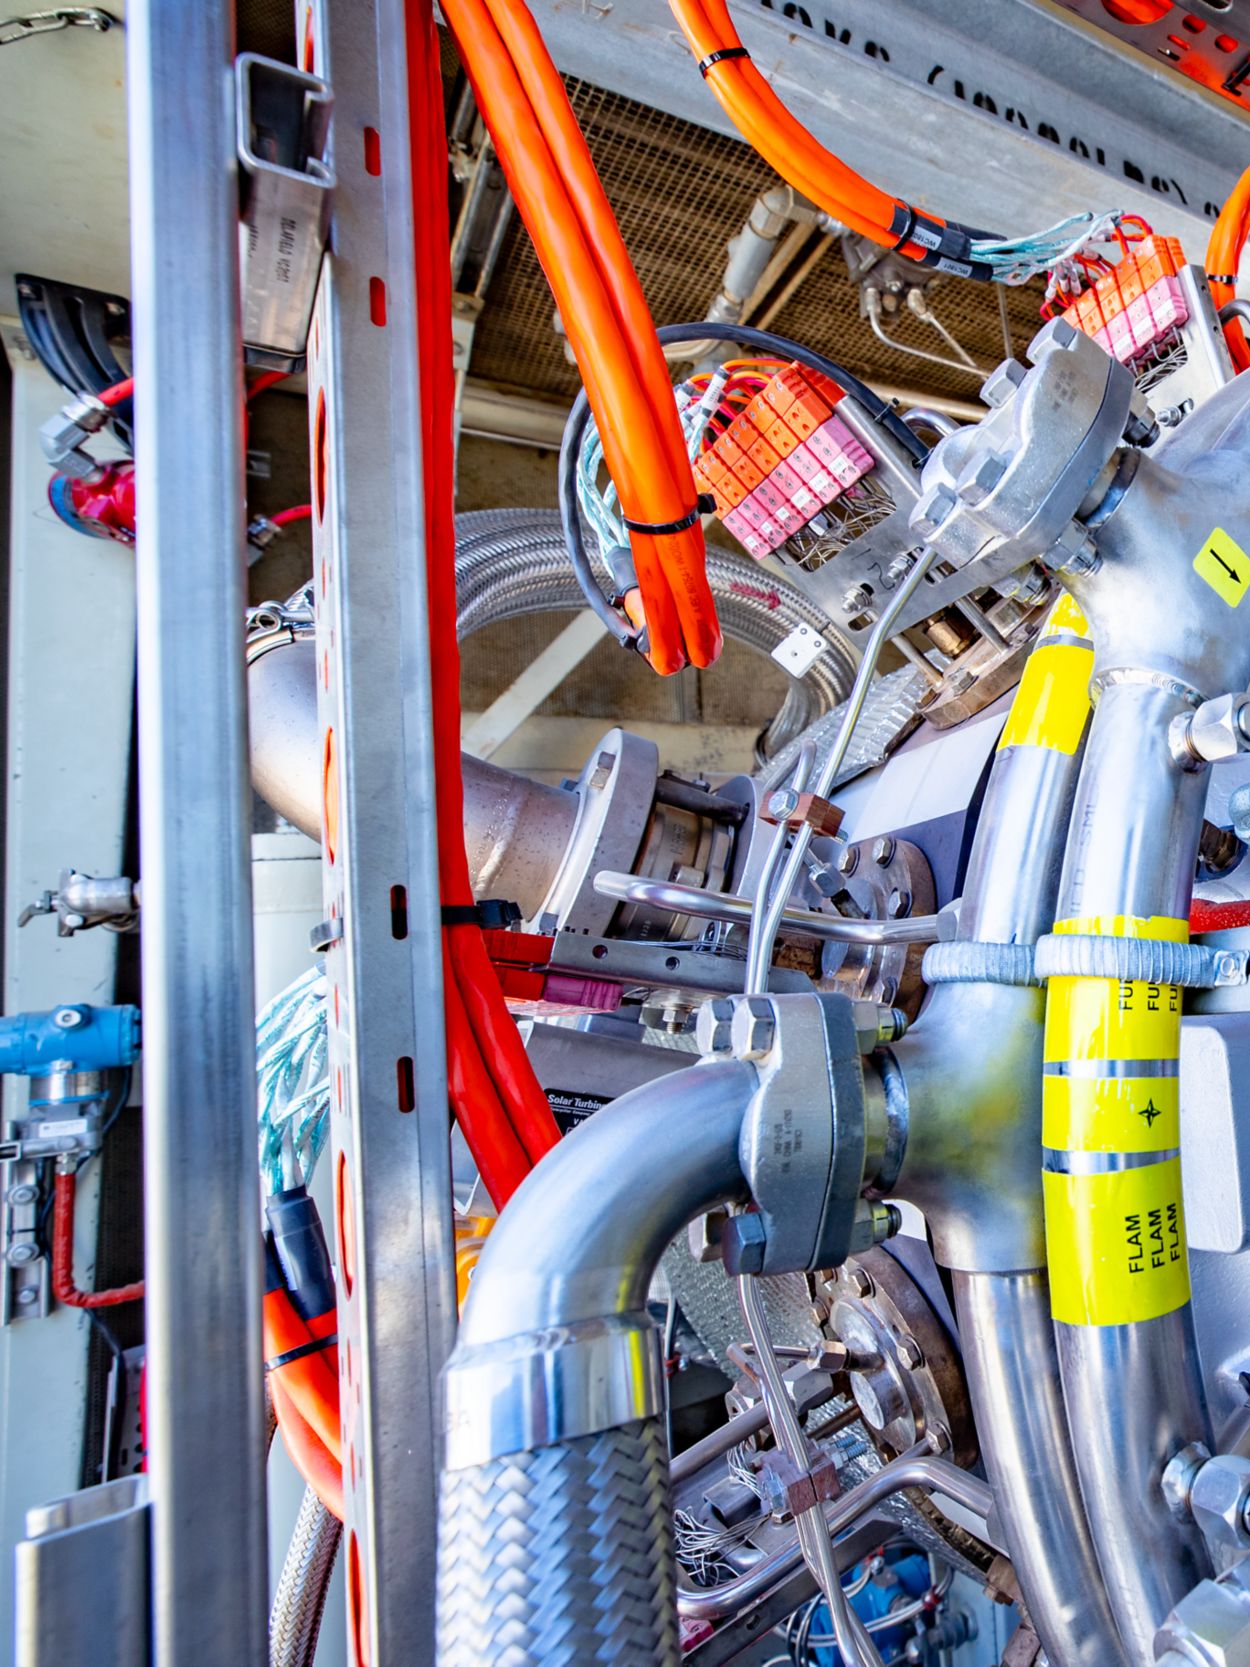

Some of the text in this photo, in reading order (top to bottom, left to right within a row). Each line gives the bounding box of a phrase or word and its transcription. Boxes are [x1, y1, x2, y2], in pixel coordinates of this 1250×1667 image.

[547, 1094, 606, 1109] Solar Turbin
[1125, 1214, 1145, 1273] FLAM
[1147, 1209, 1165, 1269] FLAM
[1166, 1202, 1181, 1262] FLAM
